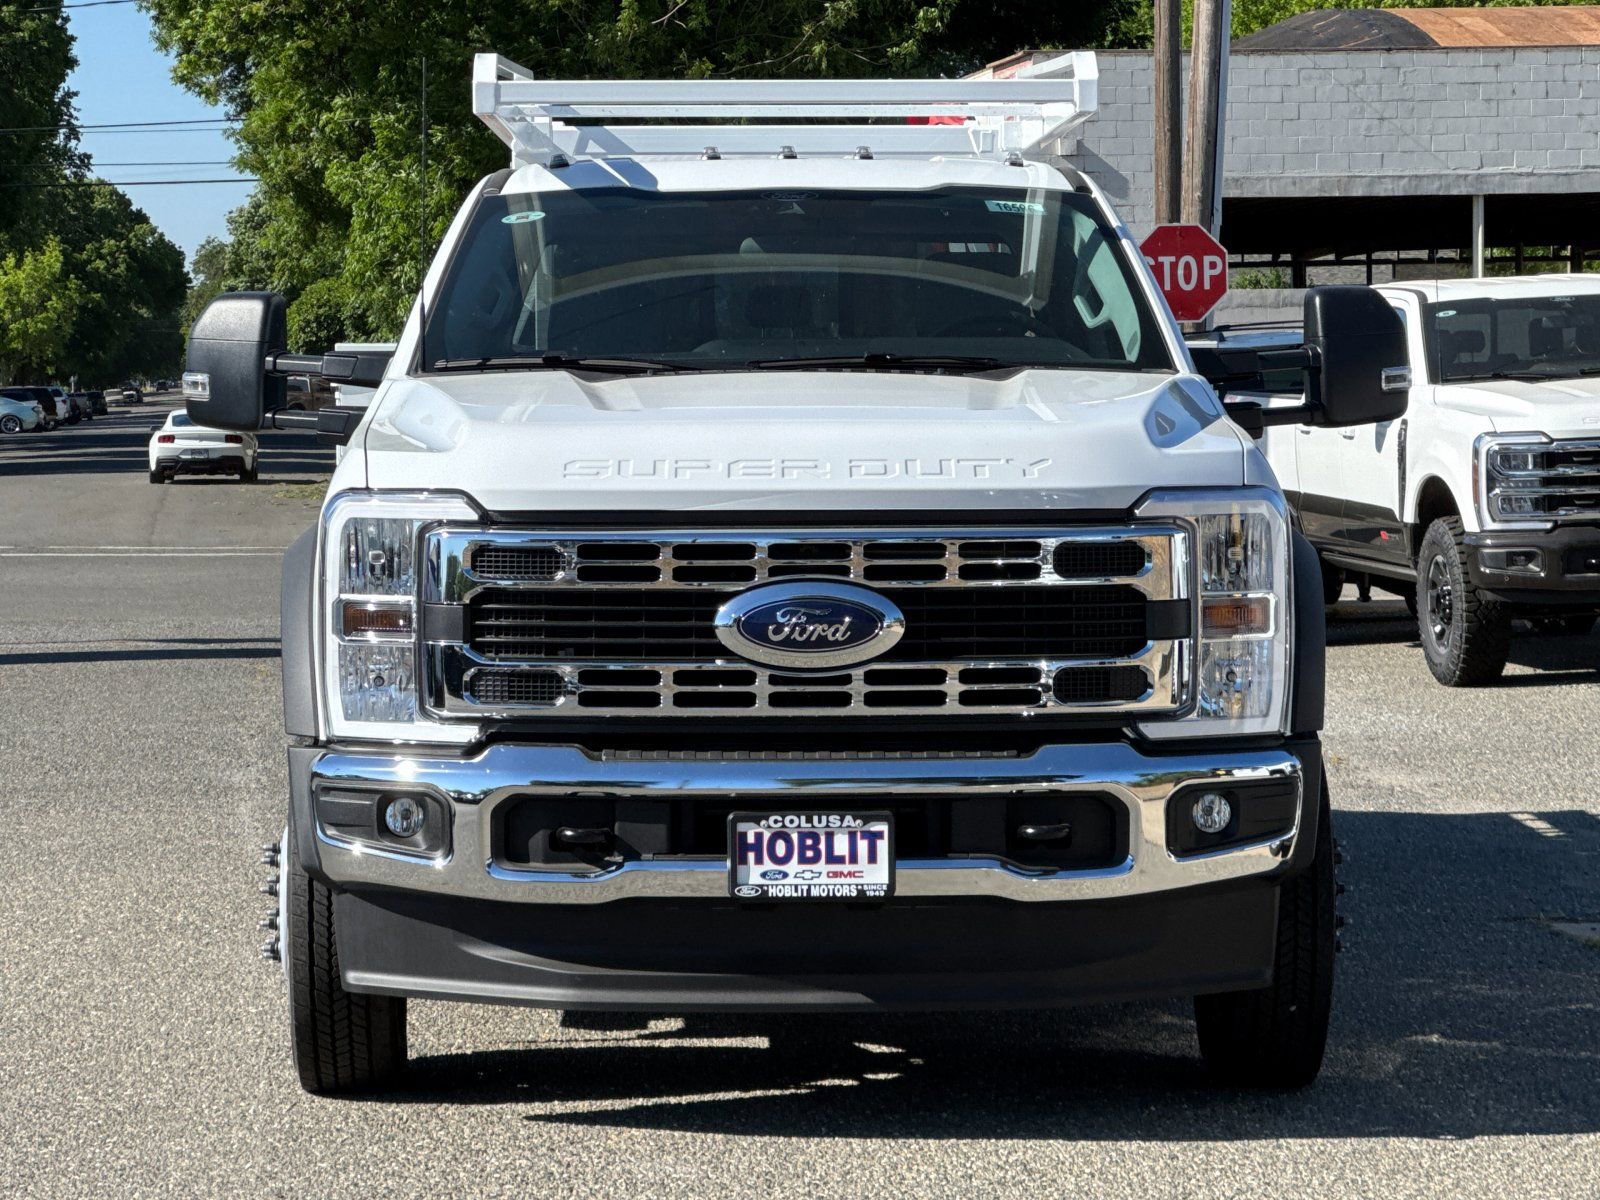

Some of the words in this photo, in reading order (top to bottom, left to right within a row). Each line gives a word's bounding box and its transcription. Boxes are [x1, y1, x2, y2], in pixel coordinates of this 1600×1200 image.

[563, 459, 830, 479] SUPER
[849, 458, 1052, 479] DUTY
[767, 606, 852, 642] Ford
[768, 815, 856, 828] COLUSA
[737, 830, 885, 866] HOBLIT
[764, 871, 784, 880] Ford
[826, 870, 864, 879] GMC
[768, 885, 808, 897] HOBLIT
[811, 885, 858, 897] MOTORS
